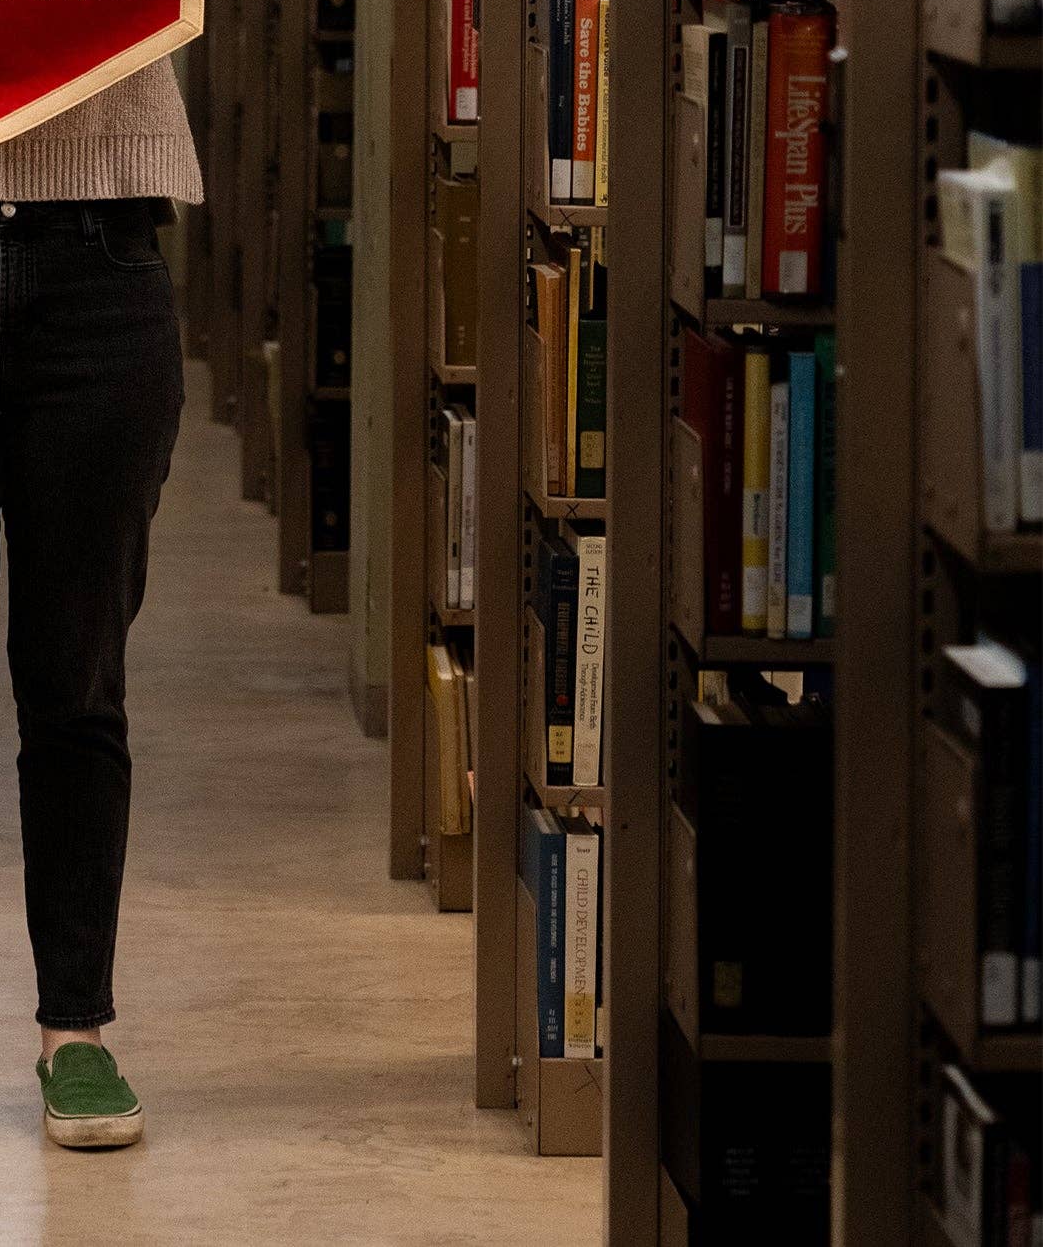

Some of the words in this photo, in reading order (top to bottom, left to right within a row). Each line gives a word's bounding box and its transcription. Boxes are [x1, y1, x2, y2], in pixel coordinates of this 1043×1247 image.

[579, 17, 593, 57] Save
[578, 61, 592, 89] the
[576, 93, 592, 151] Babies
[775, 74, 826, 174] LifeSpan
[784, 182, 819, 235] Plus
[585, 565, 600, 597] THE
[575, 868, 589, 907] CHILD
